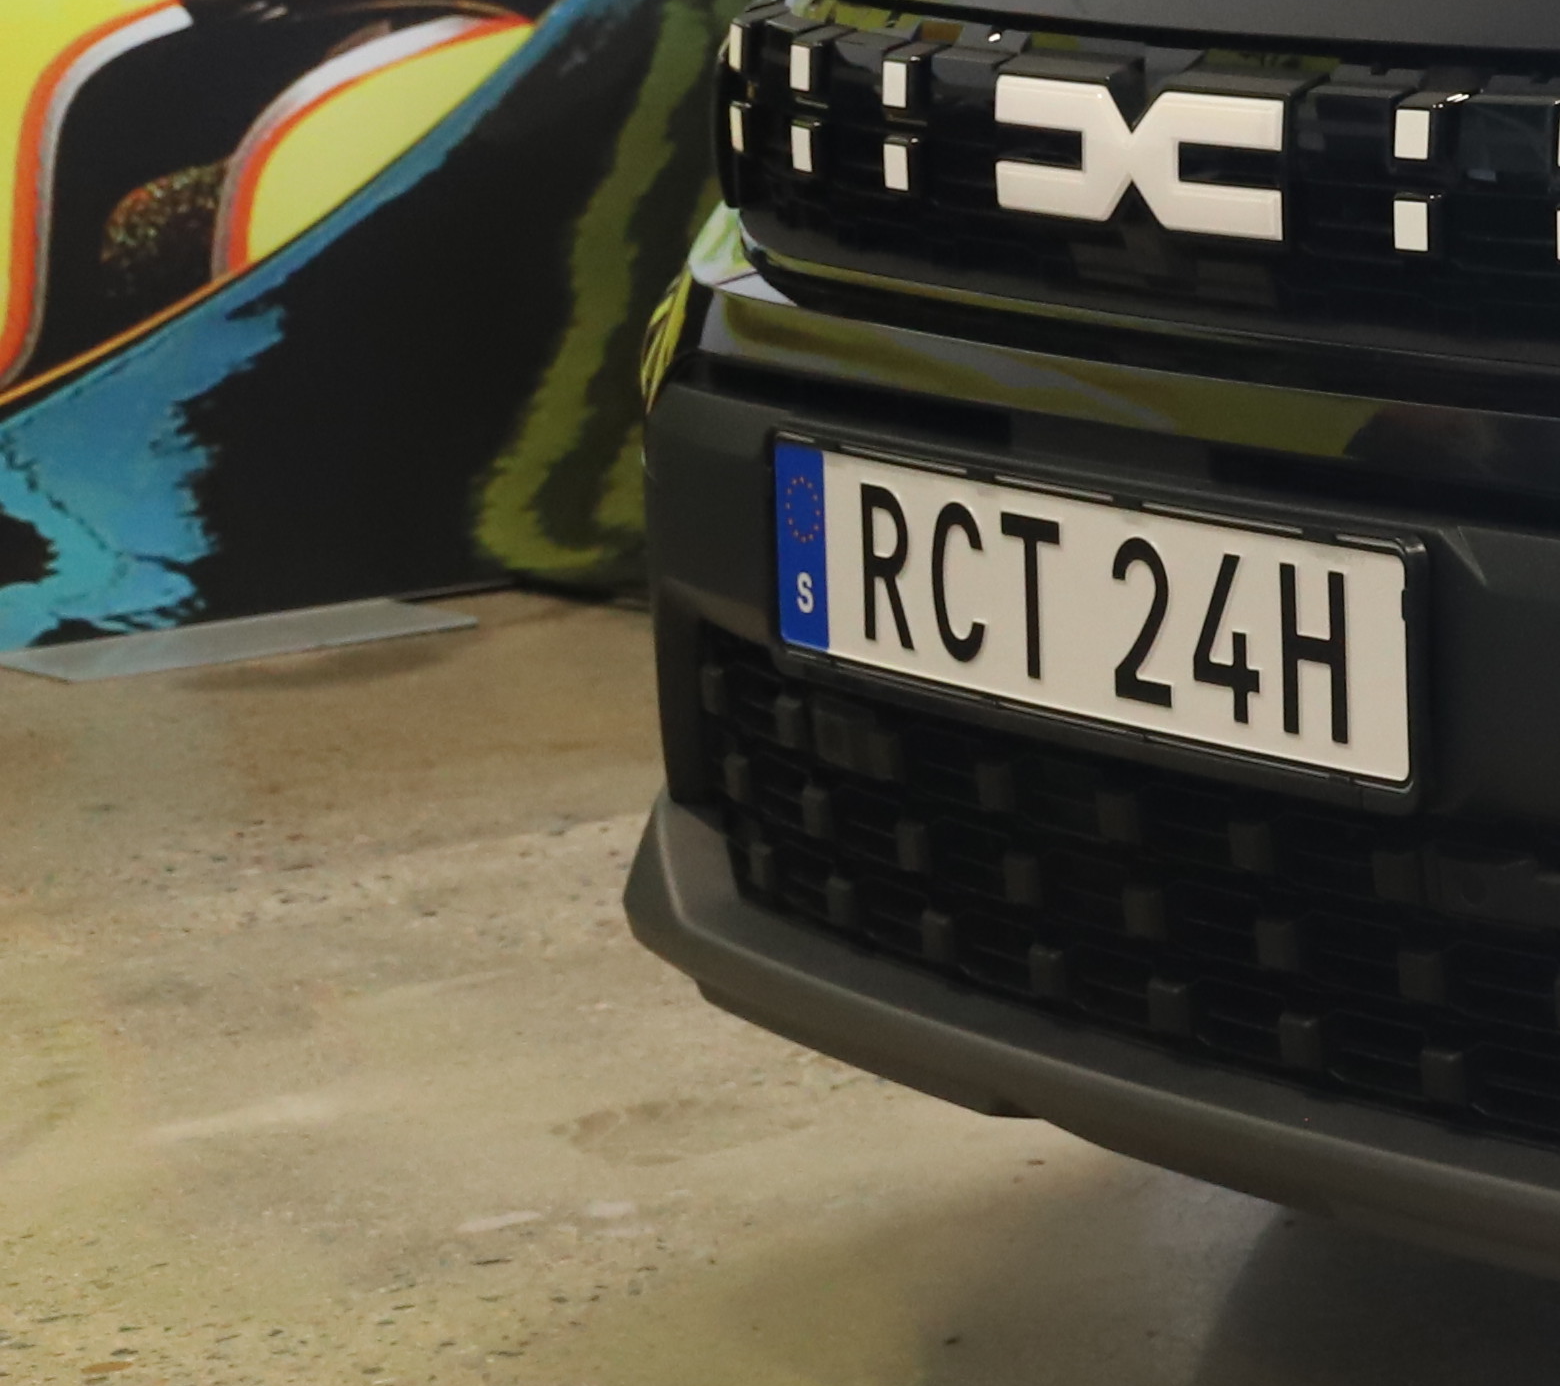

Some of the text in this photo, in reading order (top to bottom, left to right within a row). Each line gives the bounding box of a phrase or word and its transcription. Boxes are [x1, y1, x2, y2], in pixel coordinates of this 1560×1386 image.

[797, 571, 814, 614] S
[860, 483, 1349, 745] RCT 24H
